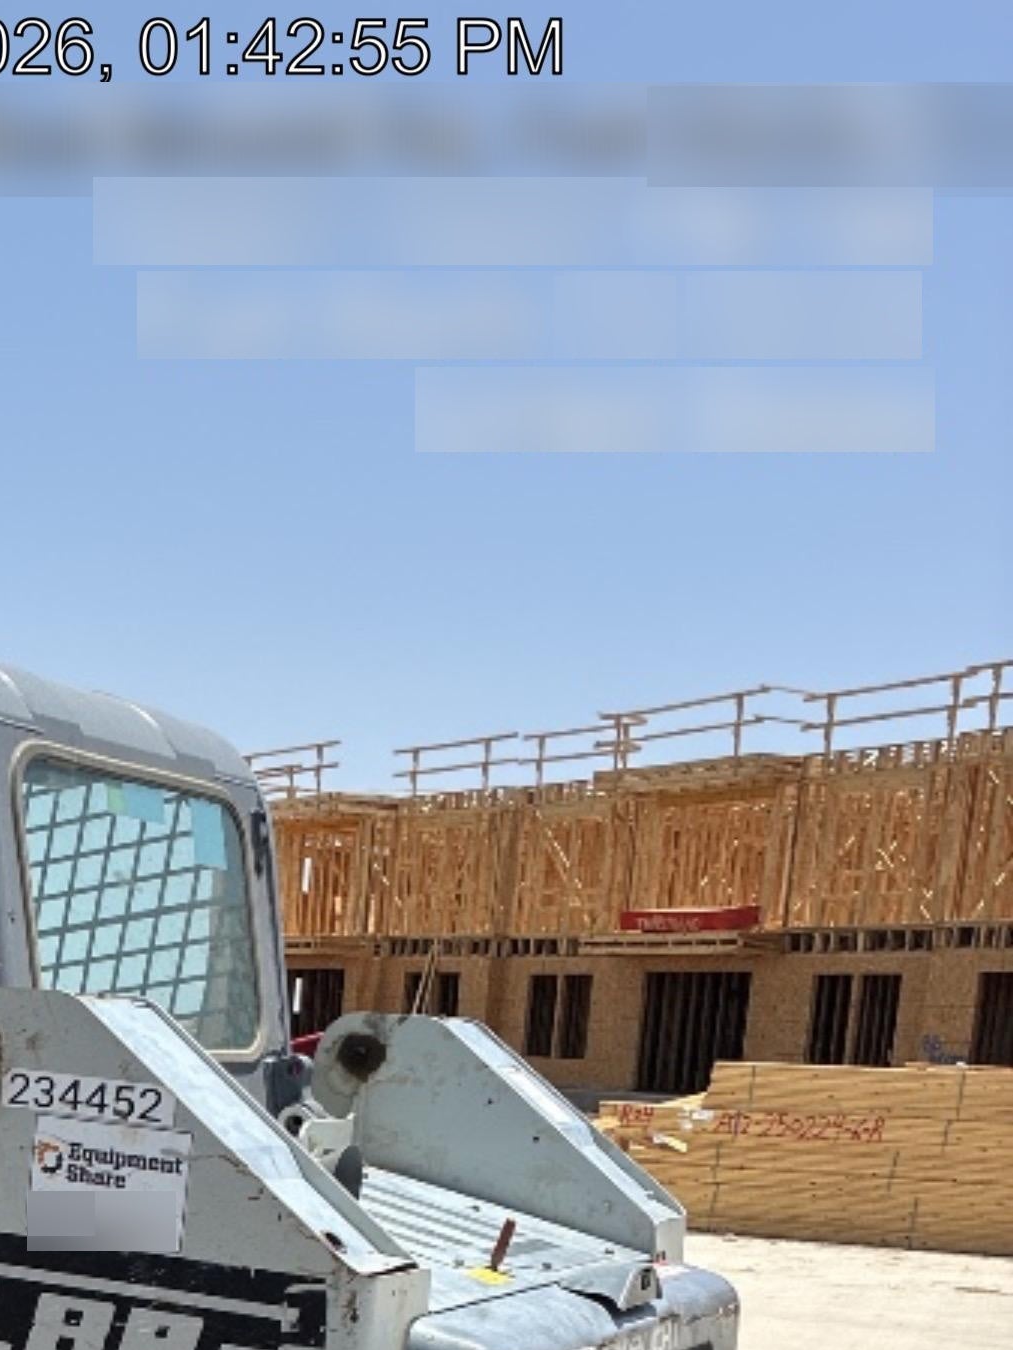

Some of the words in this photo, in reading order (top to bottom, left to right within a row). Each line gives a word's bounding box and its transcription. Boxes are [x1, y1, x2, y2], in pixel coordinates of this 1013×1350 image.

[8, 1073, 163, 1123] 234452
[68, 1143, 183, 1174] Equipment
[66, 1164, 126, 1188] Share
